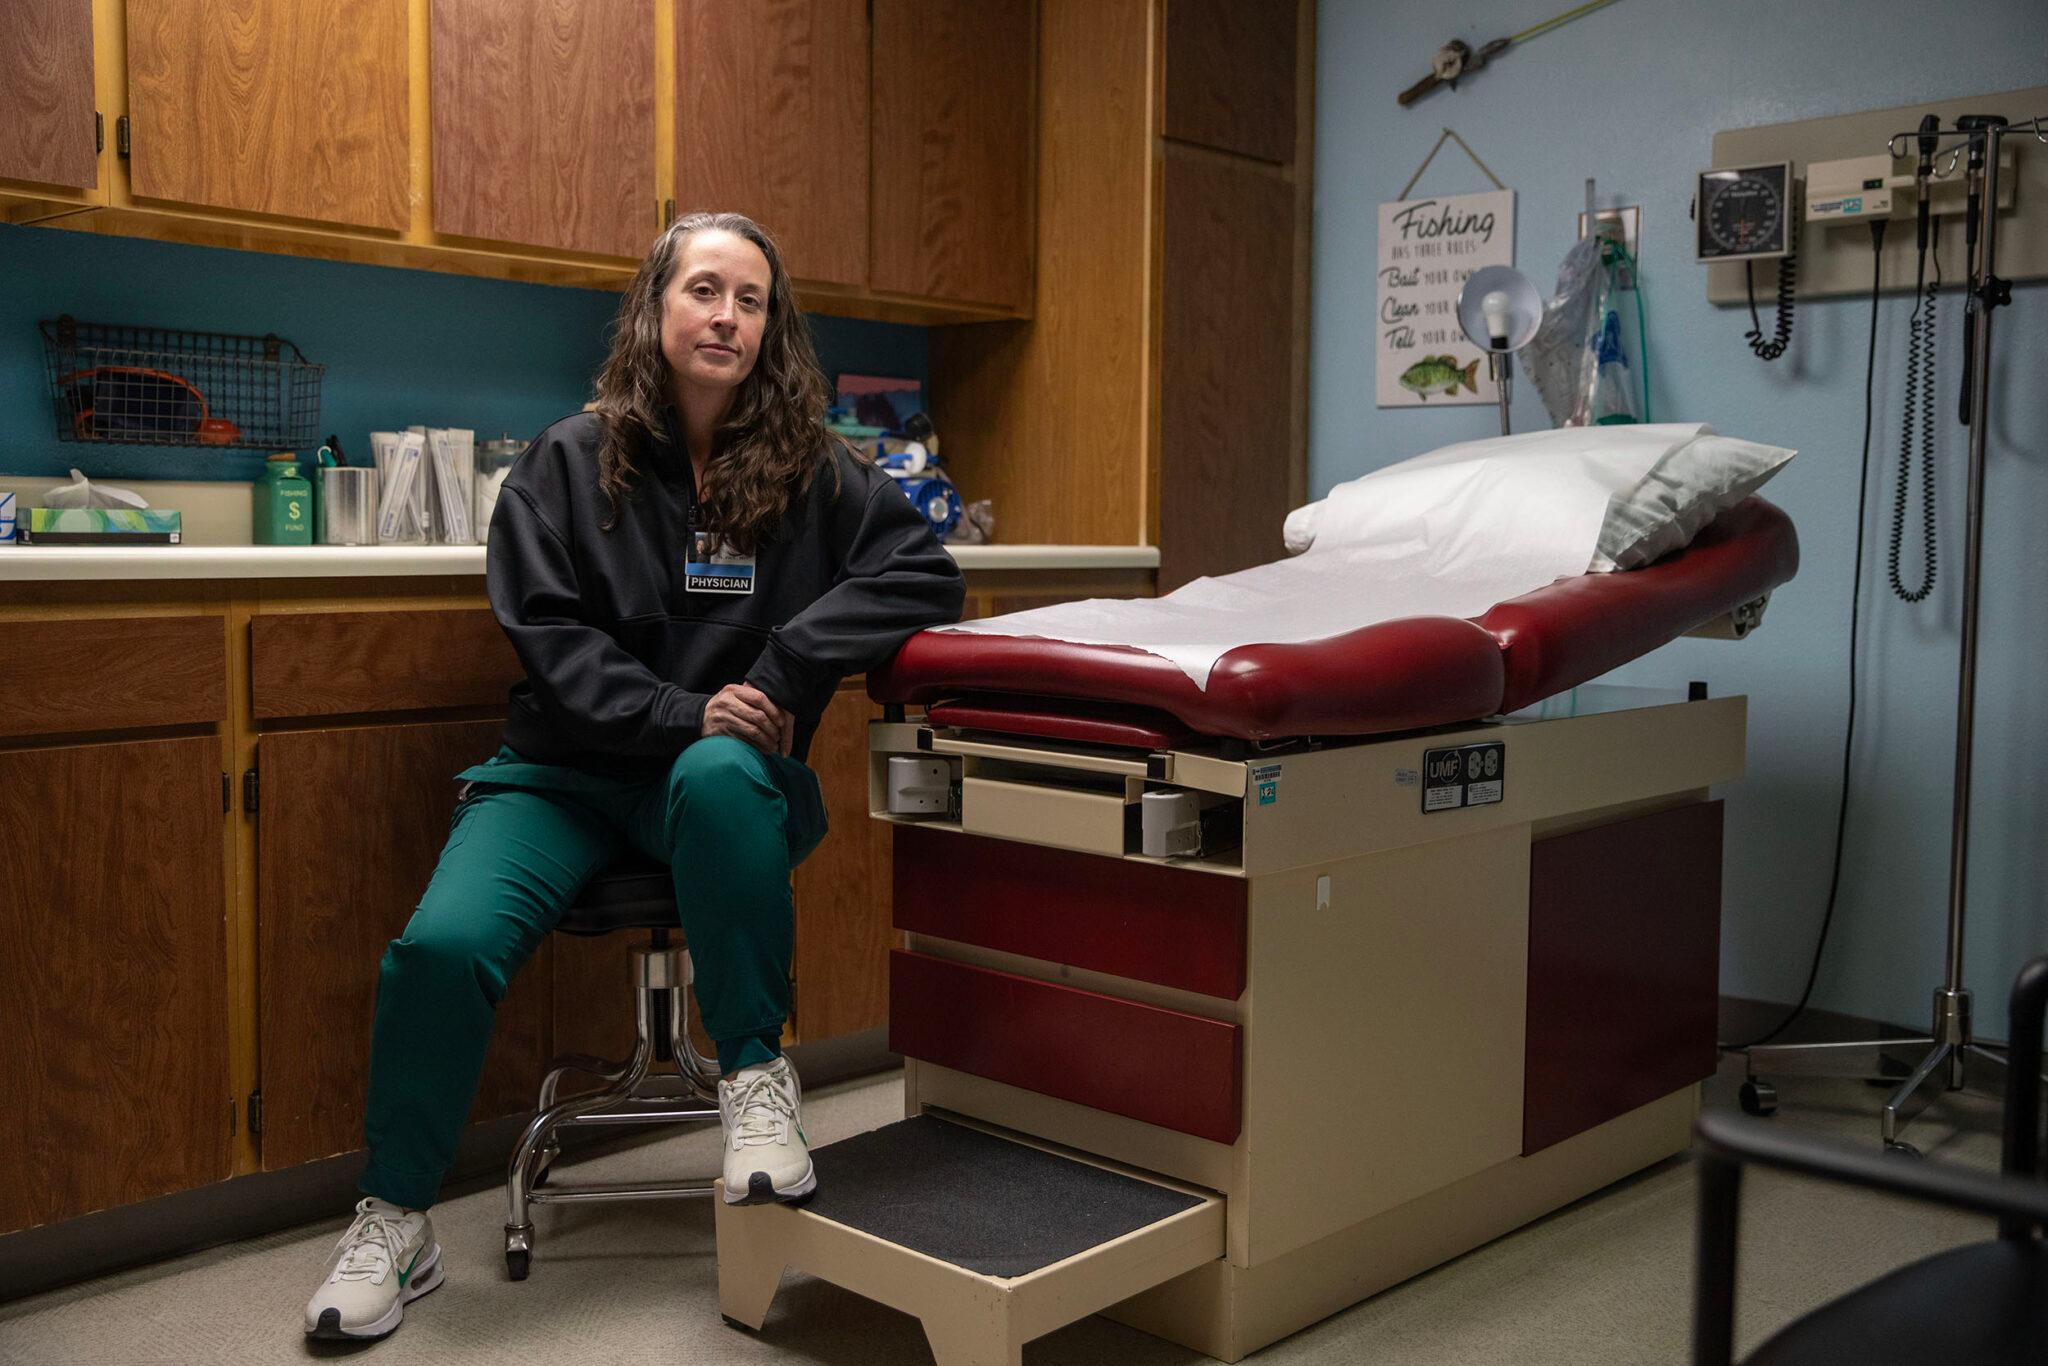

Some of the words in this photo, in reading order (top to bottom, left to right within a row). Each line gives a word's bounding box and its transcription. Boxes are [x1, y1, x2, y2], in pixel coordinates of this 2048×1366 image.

[1392, 201, 1495, 244] Fishing
[1379, 266, 1420, 289] Bait
[1424, 270, 1448, 285] YOUR
[1381, 296, 1420, 325] Clean
[1424, 301, 1449, 315] YOUR
[1384, 326, 1416, 349] Tell
[1422, 329, 1446, 344] YOUR
[691, 577, 749, 589] PHYSICIAN
[1429, 759, 1459, 779] UMF
